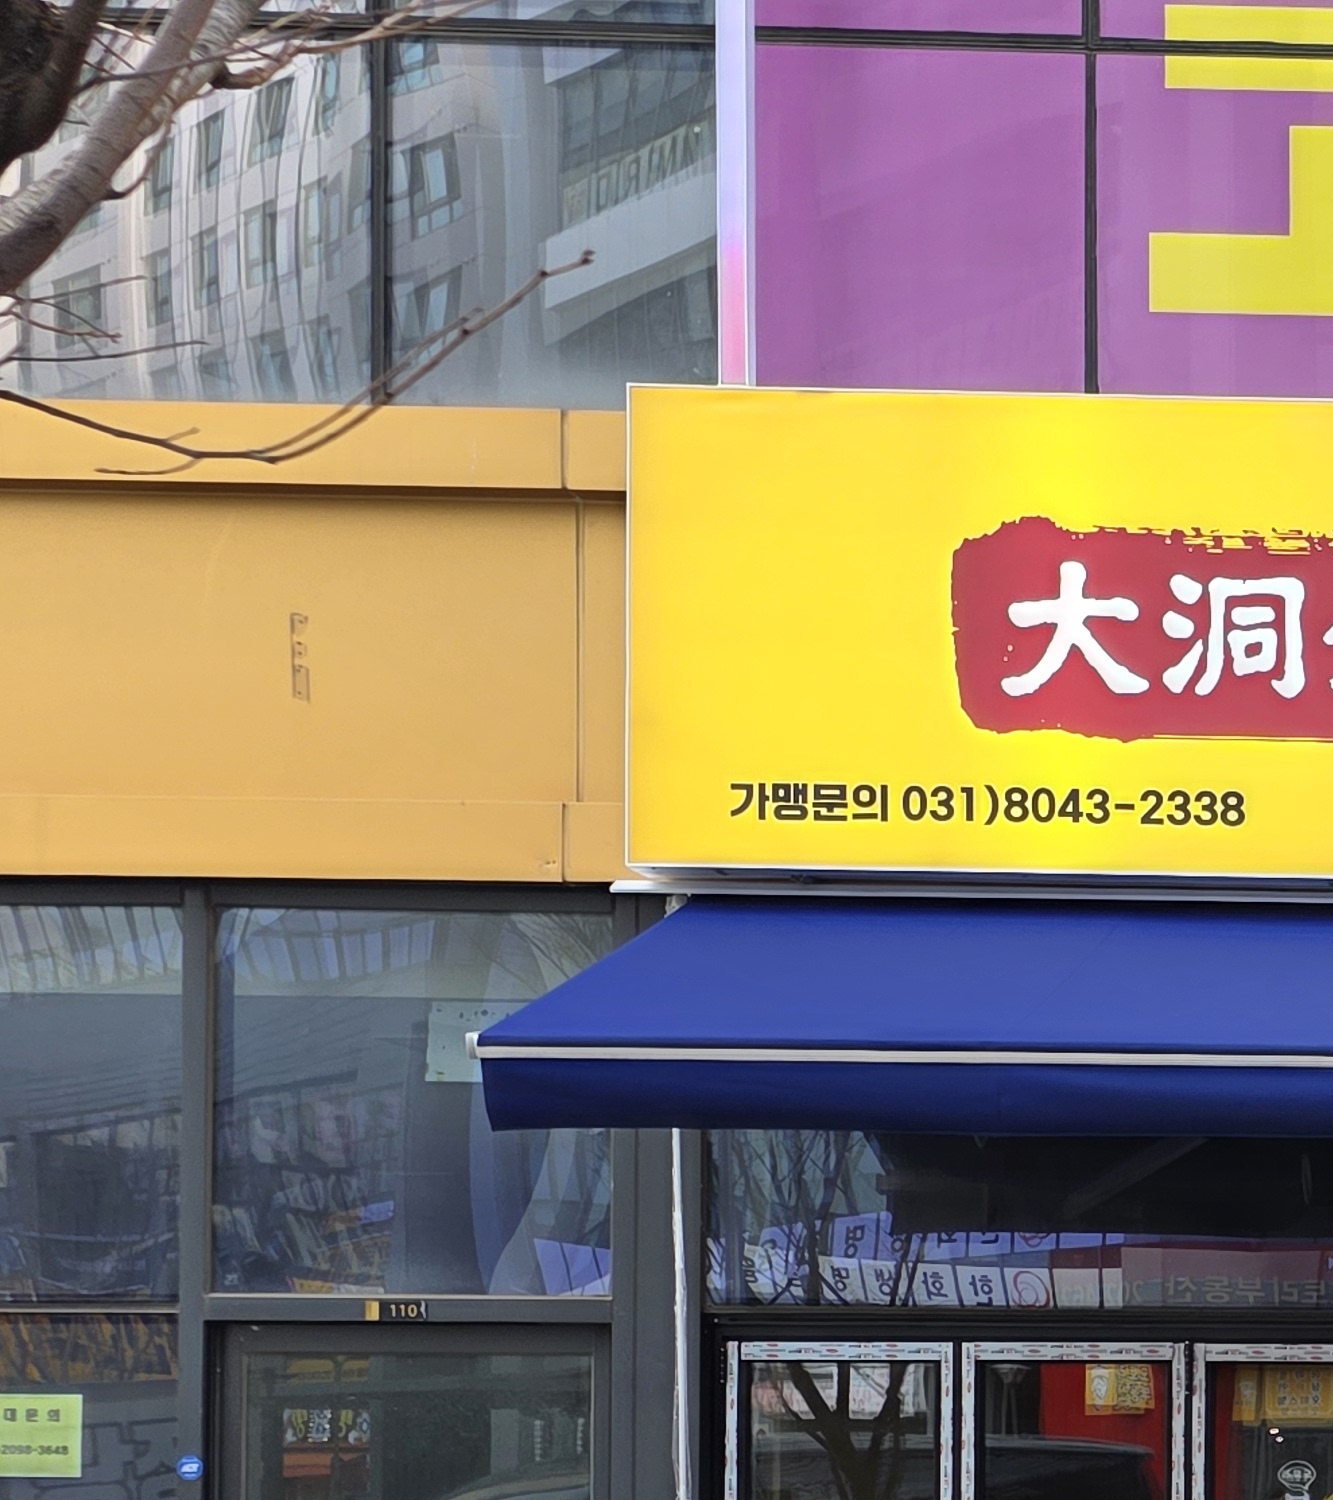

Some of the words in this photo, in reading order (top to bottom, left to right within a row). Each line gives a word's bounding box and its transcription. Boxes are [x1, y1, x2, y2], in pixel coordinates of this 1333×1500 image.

[729, 782, 889, 823] 가맹문의
[902, 785, 1246, 829] 031)8043-2338
[390, 1304, 418, 1317] 110
